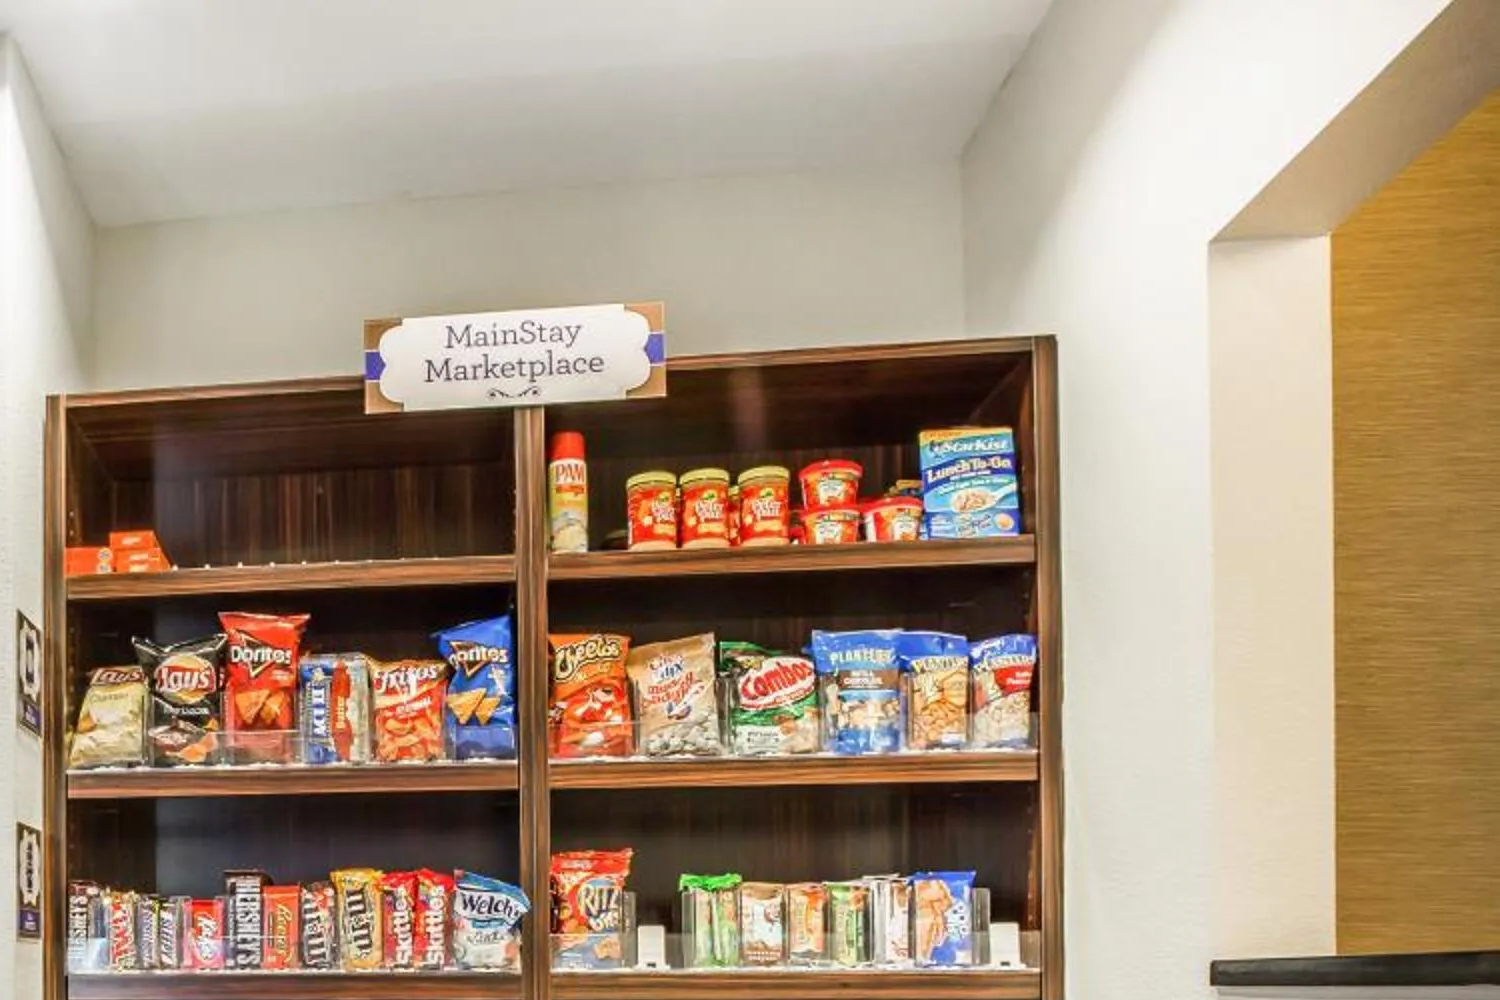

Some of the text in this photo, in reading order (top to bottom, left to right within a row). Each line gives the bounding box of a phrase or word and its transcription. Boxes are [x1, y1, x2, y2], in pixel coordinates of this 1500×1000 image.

[445, 320, 582, 349] MainStay
[424, 350, 605, 383] Marketplace
[554, 463, 584, 483] PAM
[231, 646, 292, 664] Doritos
[236, 882, 261, 966] HERSHEY'S
